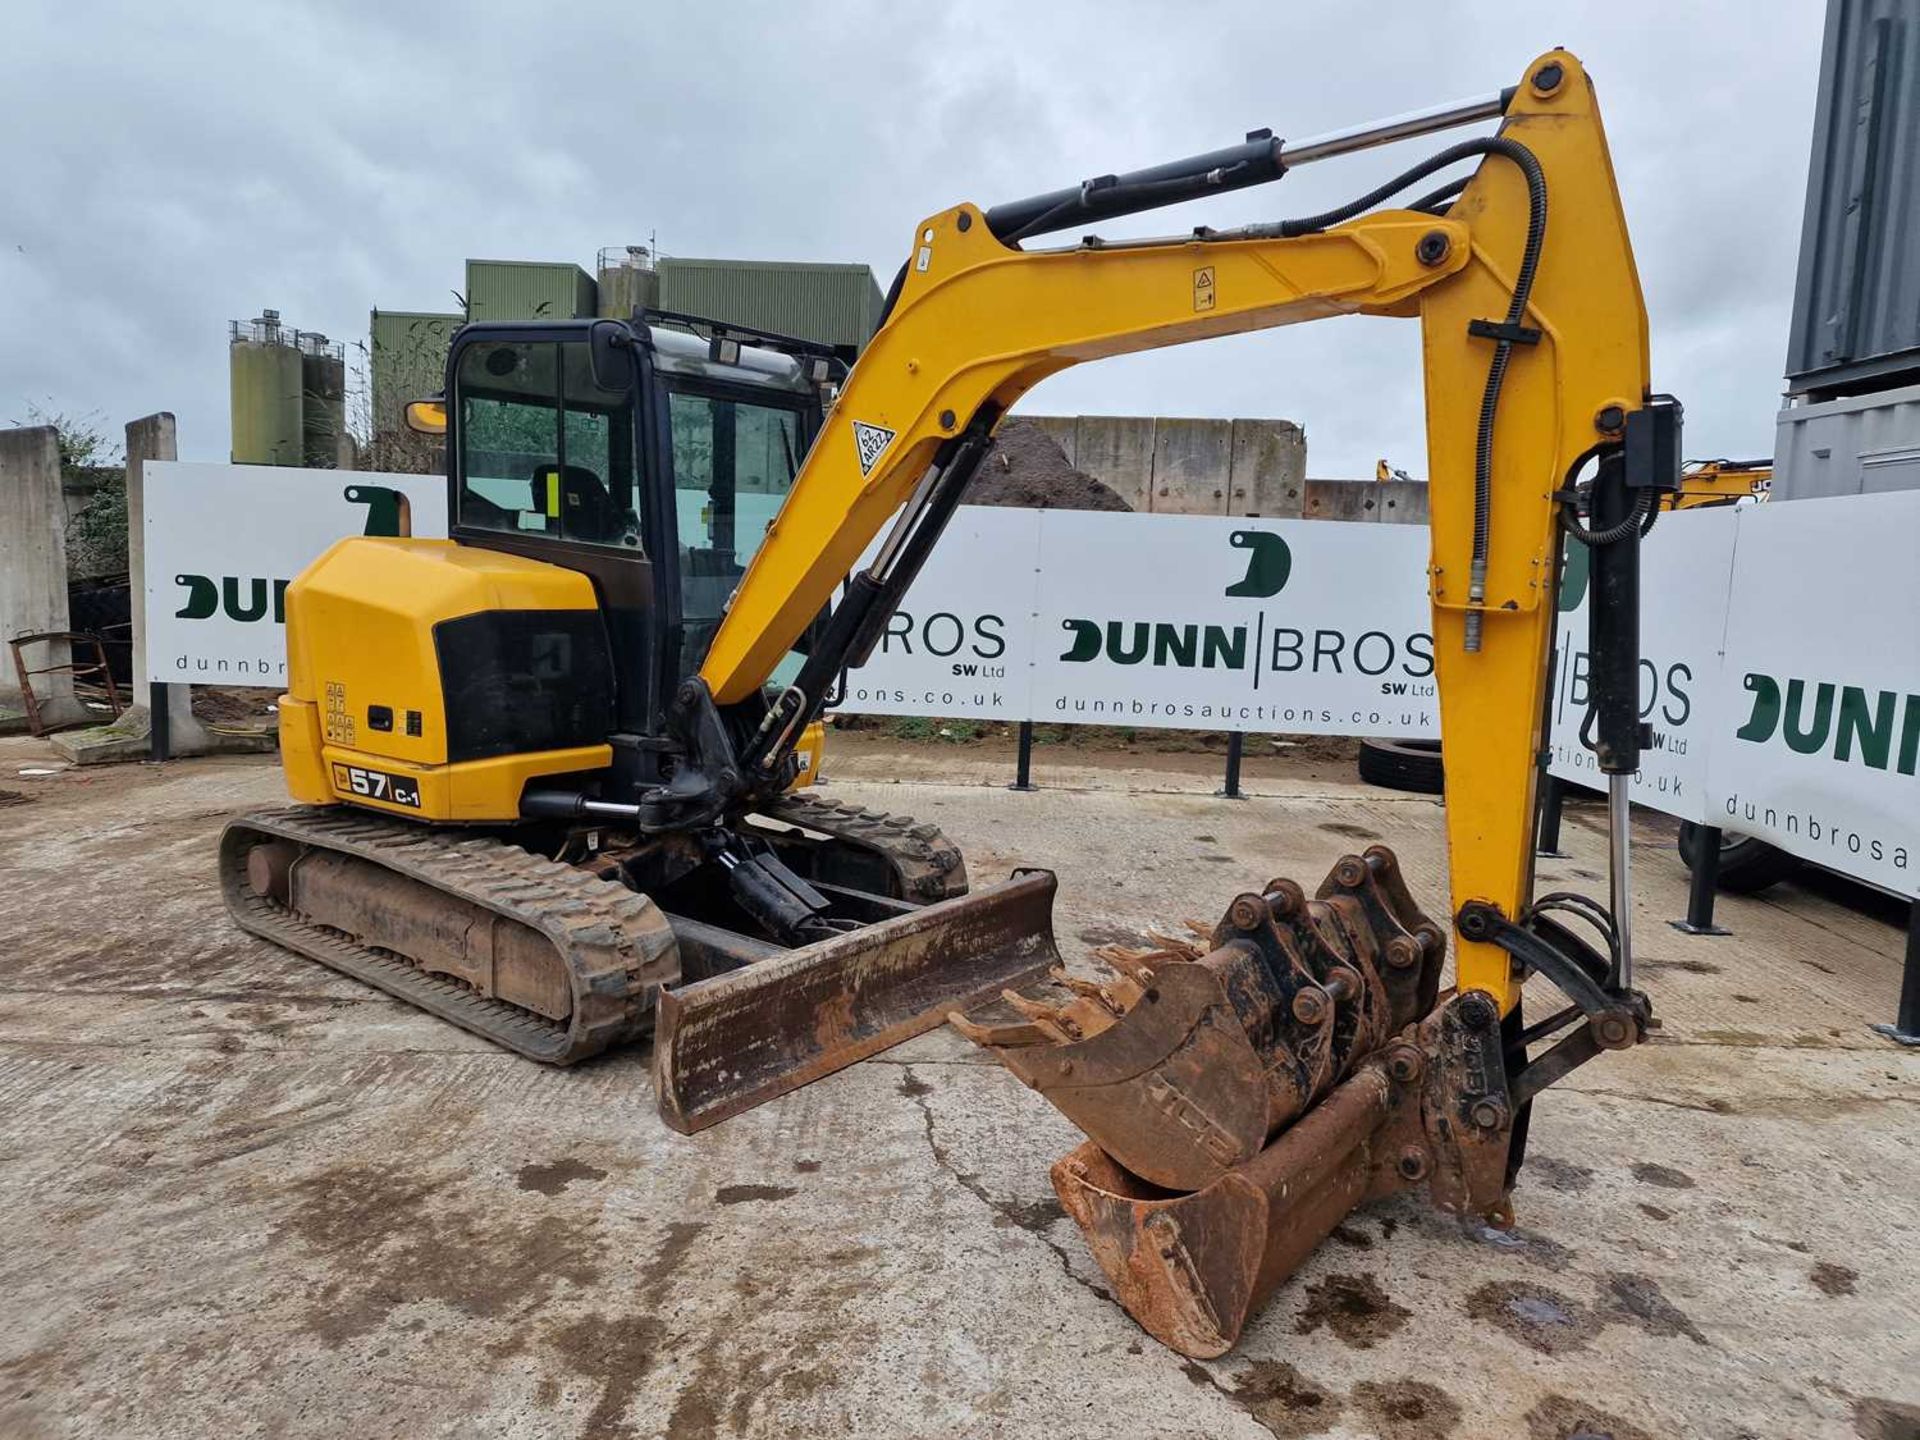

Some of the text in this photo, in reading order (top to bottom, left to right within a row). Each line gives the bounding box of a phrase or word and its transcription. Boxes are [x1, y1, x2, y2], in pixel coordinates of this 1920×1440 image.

[175, 574, 291, 624] DU
[1059, 618, 1436, 678] DUNN BROS
[951, 664, 1006, 679] SW Ltd
[1381, 682, 1435, 698] SW Ltd
[1055, 696, 1433, 727] dunnbrosauctions.co.uk
[1668, 737, 1688, 756] Ltd
[350, 767, 387, 798] 57
